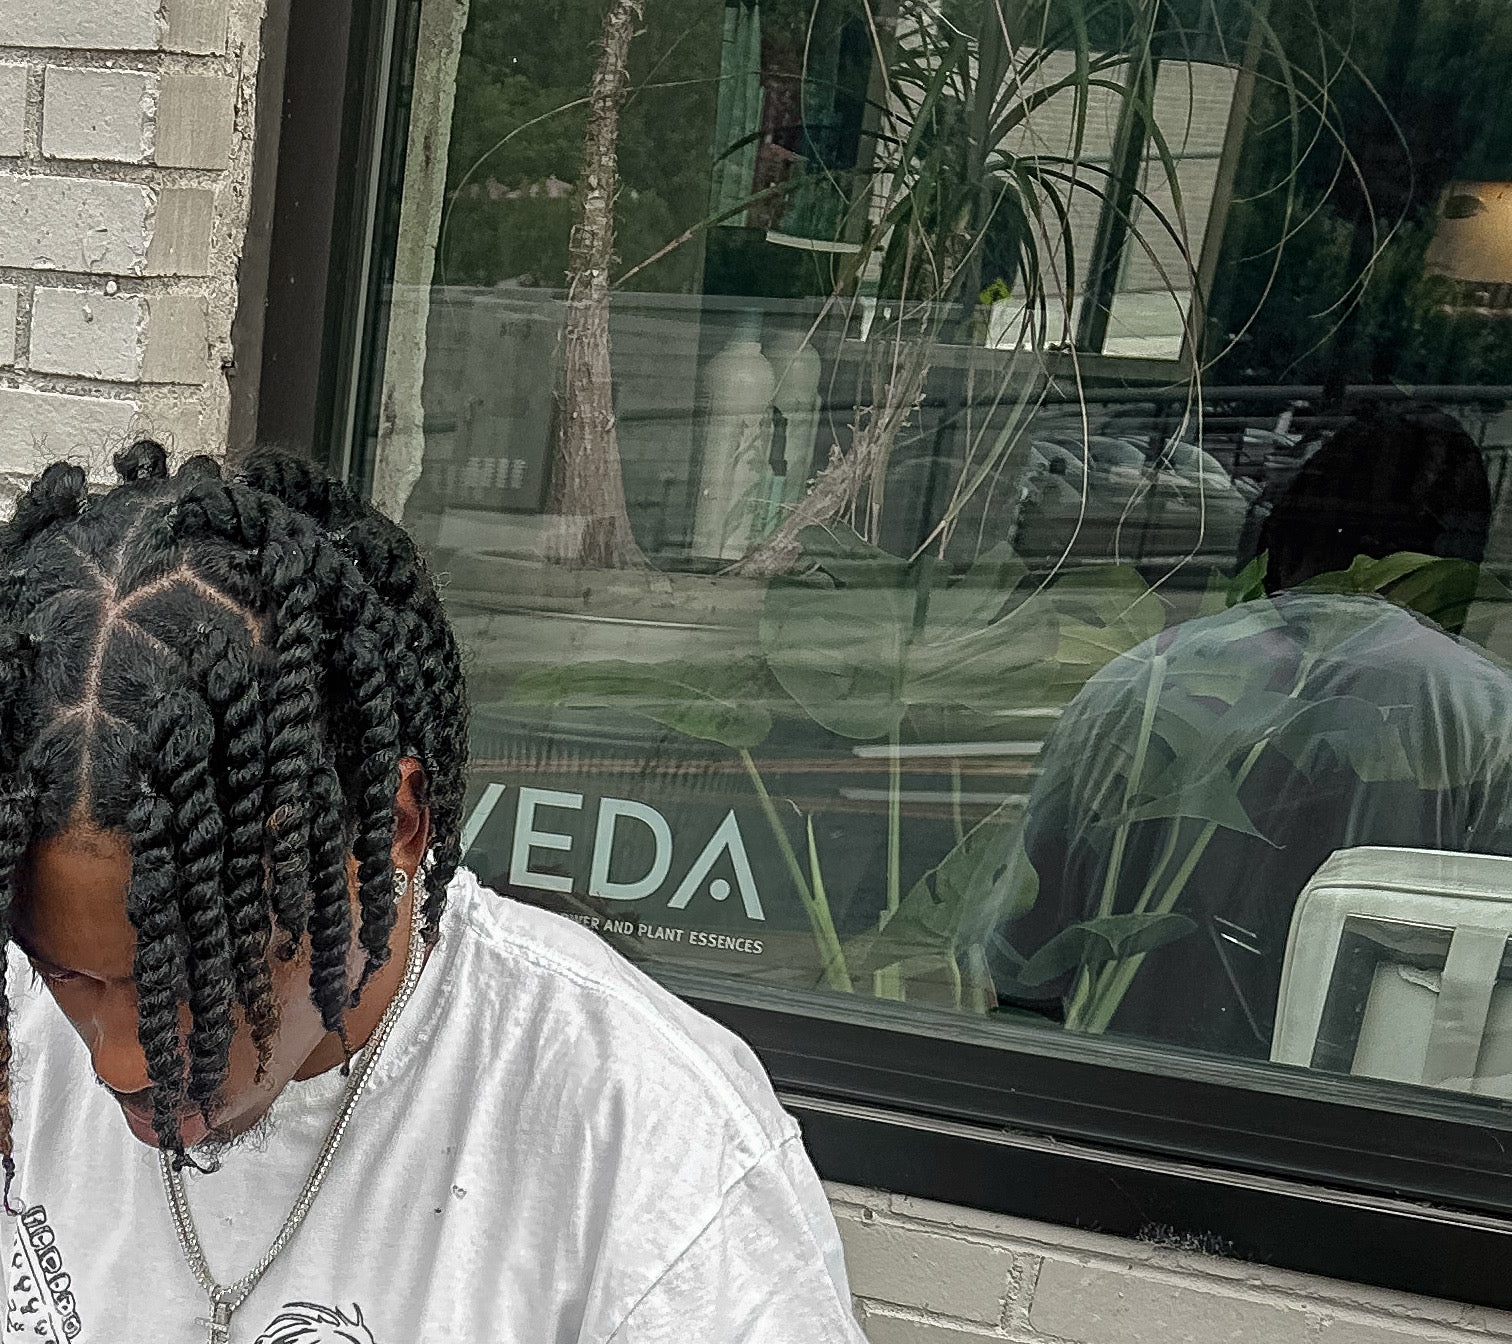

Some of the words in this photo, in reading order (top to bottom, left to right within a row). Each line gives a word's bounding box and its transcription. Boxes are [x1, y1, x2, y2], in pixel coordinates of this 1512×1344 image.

[603, 919, 634, 936] AND
[637, 923, 685, 942] PLANT
[689, 930, 764, 955] ESSENCES
